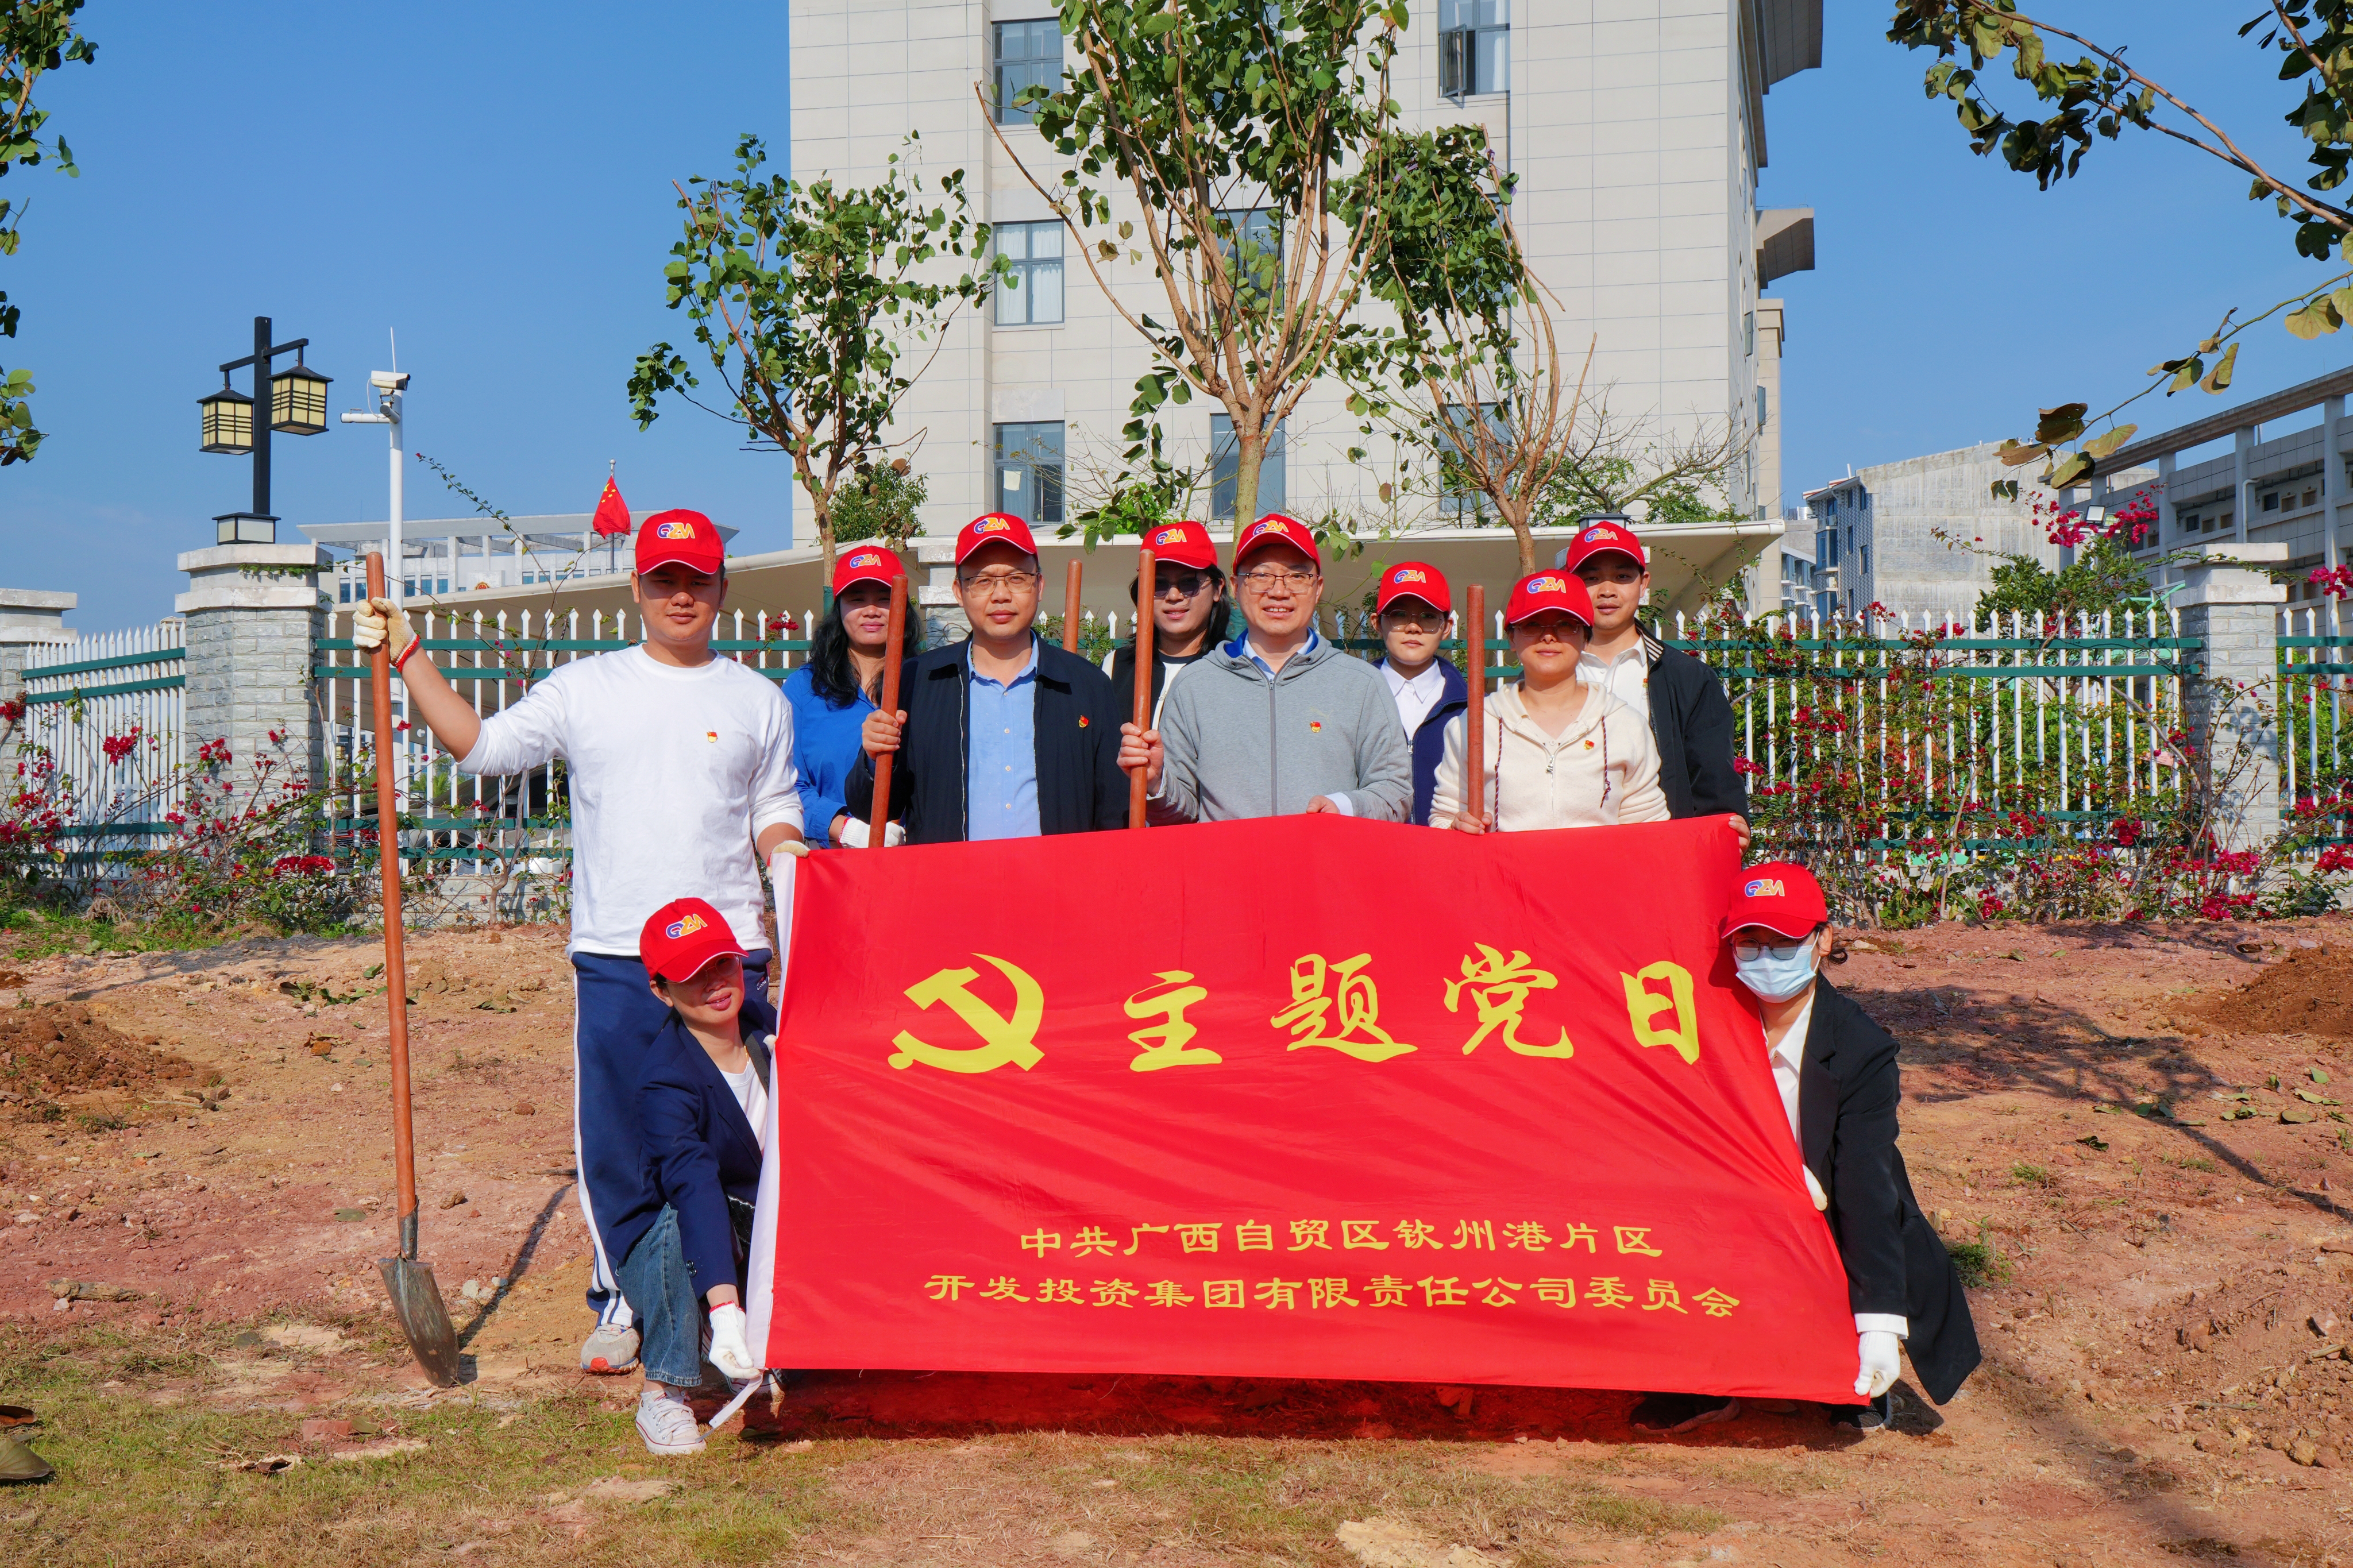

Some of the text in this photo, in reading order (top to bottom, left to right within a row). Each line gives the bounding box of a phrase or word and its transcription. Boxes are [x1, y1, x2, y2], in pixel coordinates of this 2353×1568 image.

[1124, 942, 1700, 1072] 主题党日
[1020, 1218, 1663, 1258] 中共广西自贸区钦州港片区
[923, 1274, 1741, 1318] 开发投资集团有限责任公司委员会
